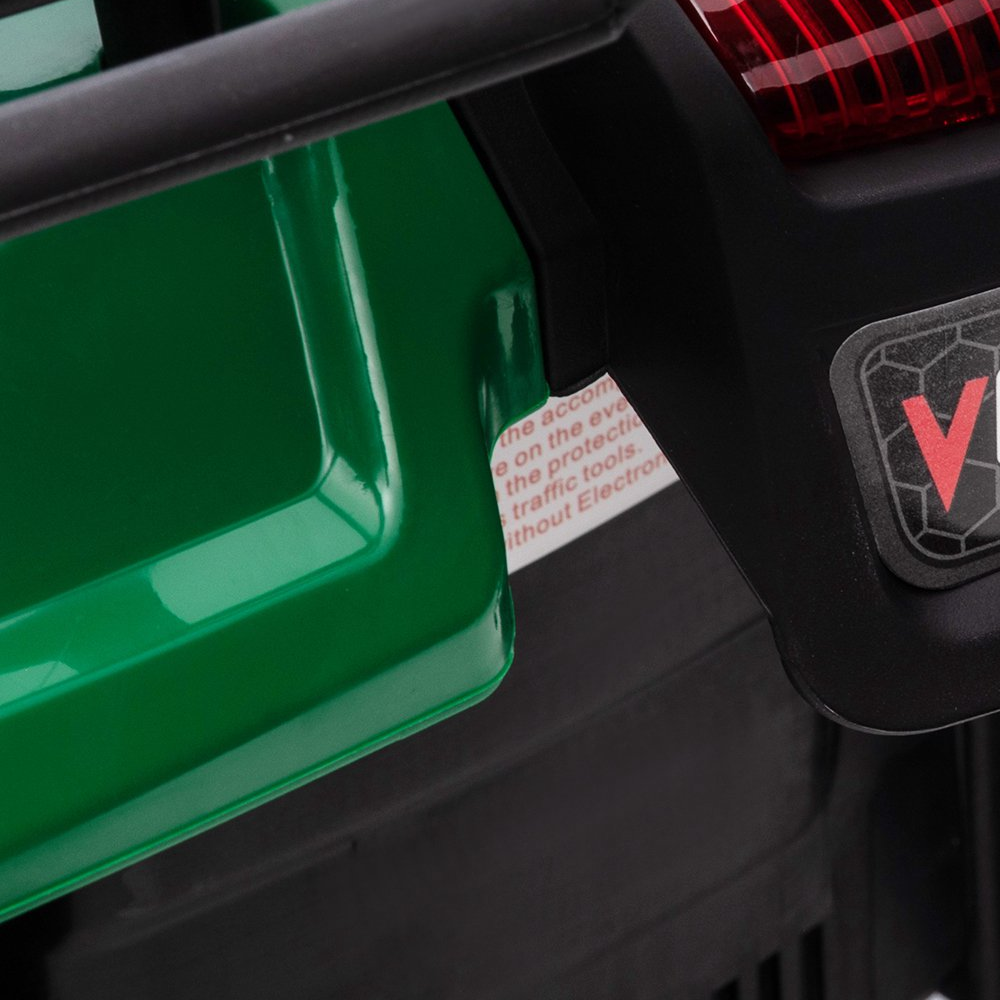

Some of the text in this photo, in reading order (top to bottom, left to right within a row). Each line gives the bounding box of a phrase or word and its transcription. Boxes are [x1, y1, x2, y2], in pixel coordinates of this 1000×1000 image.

[499, 377, 615, 448] the accom
[514, 443, 542, 467] on
[547, 420, 583, 450] the
[506, 468, 541, 496] the
[512, 443, 643, 520] traffic tools.
